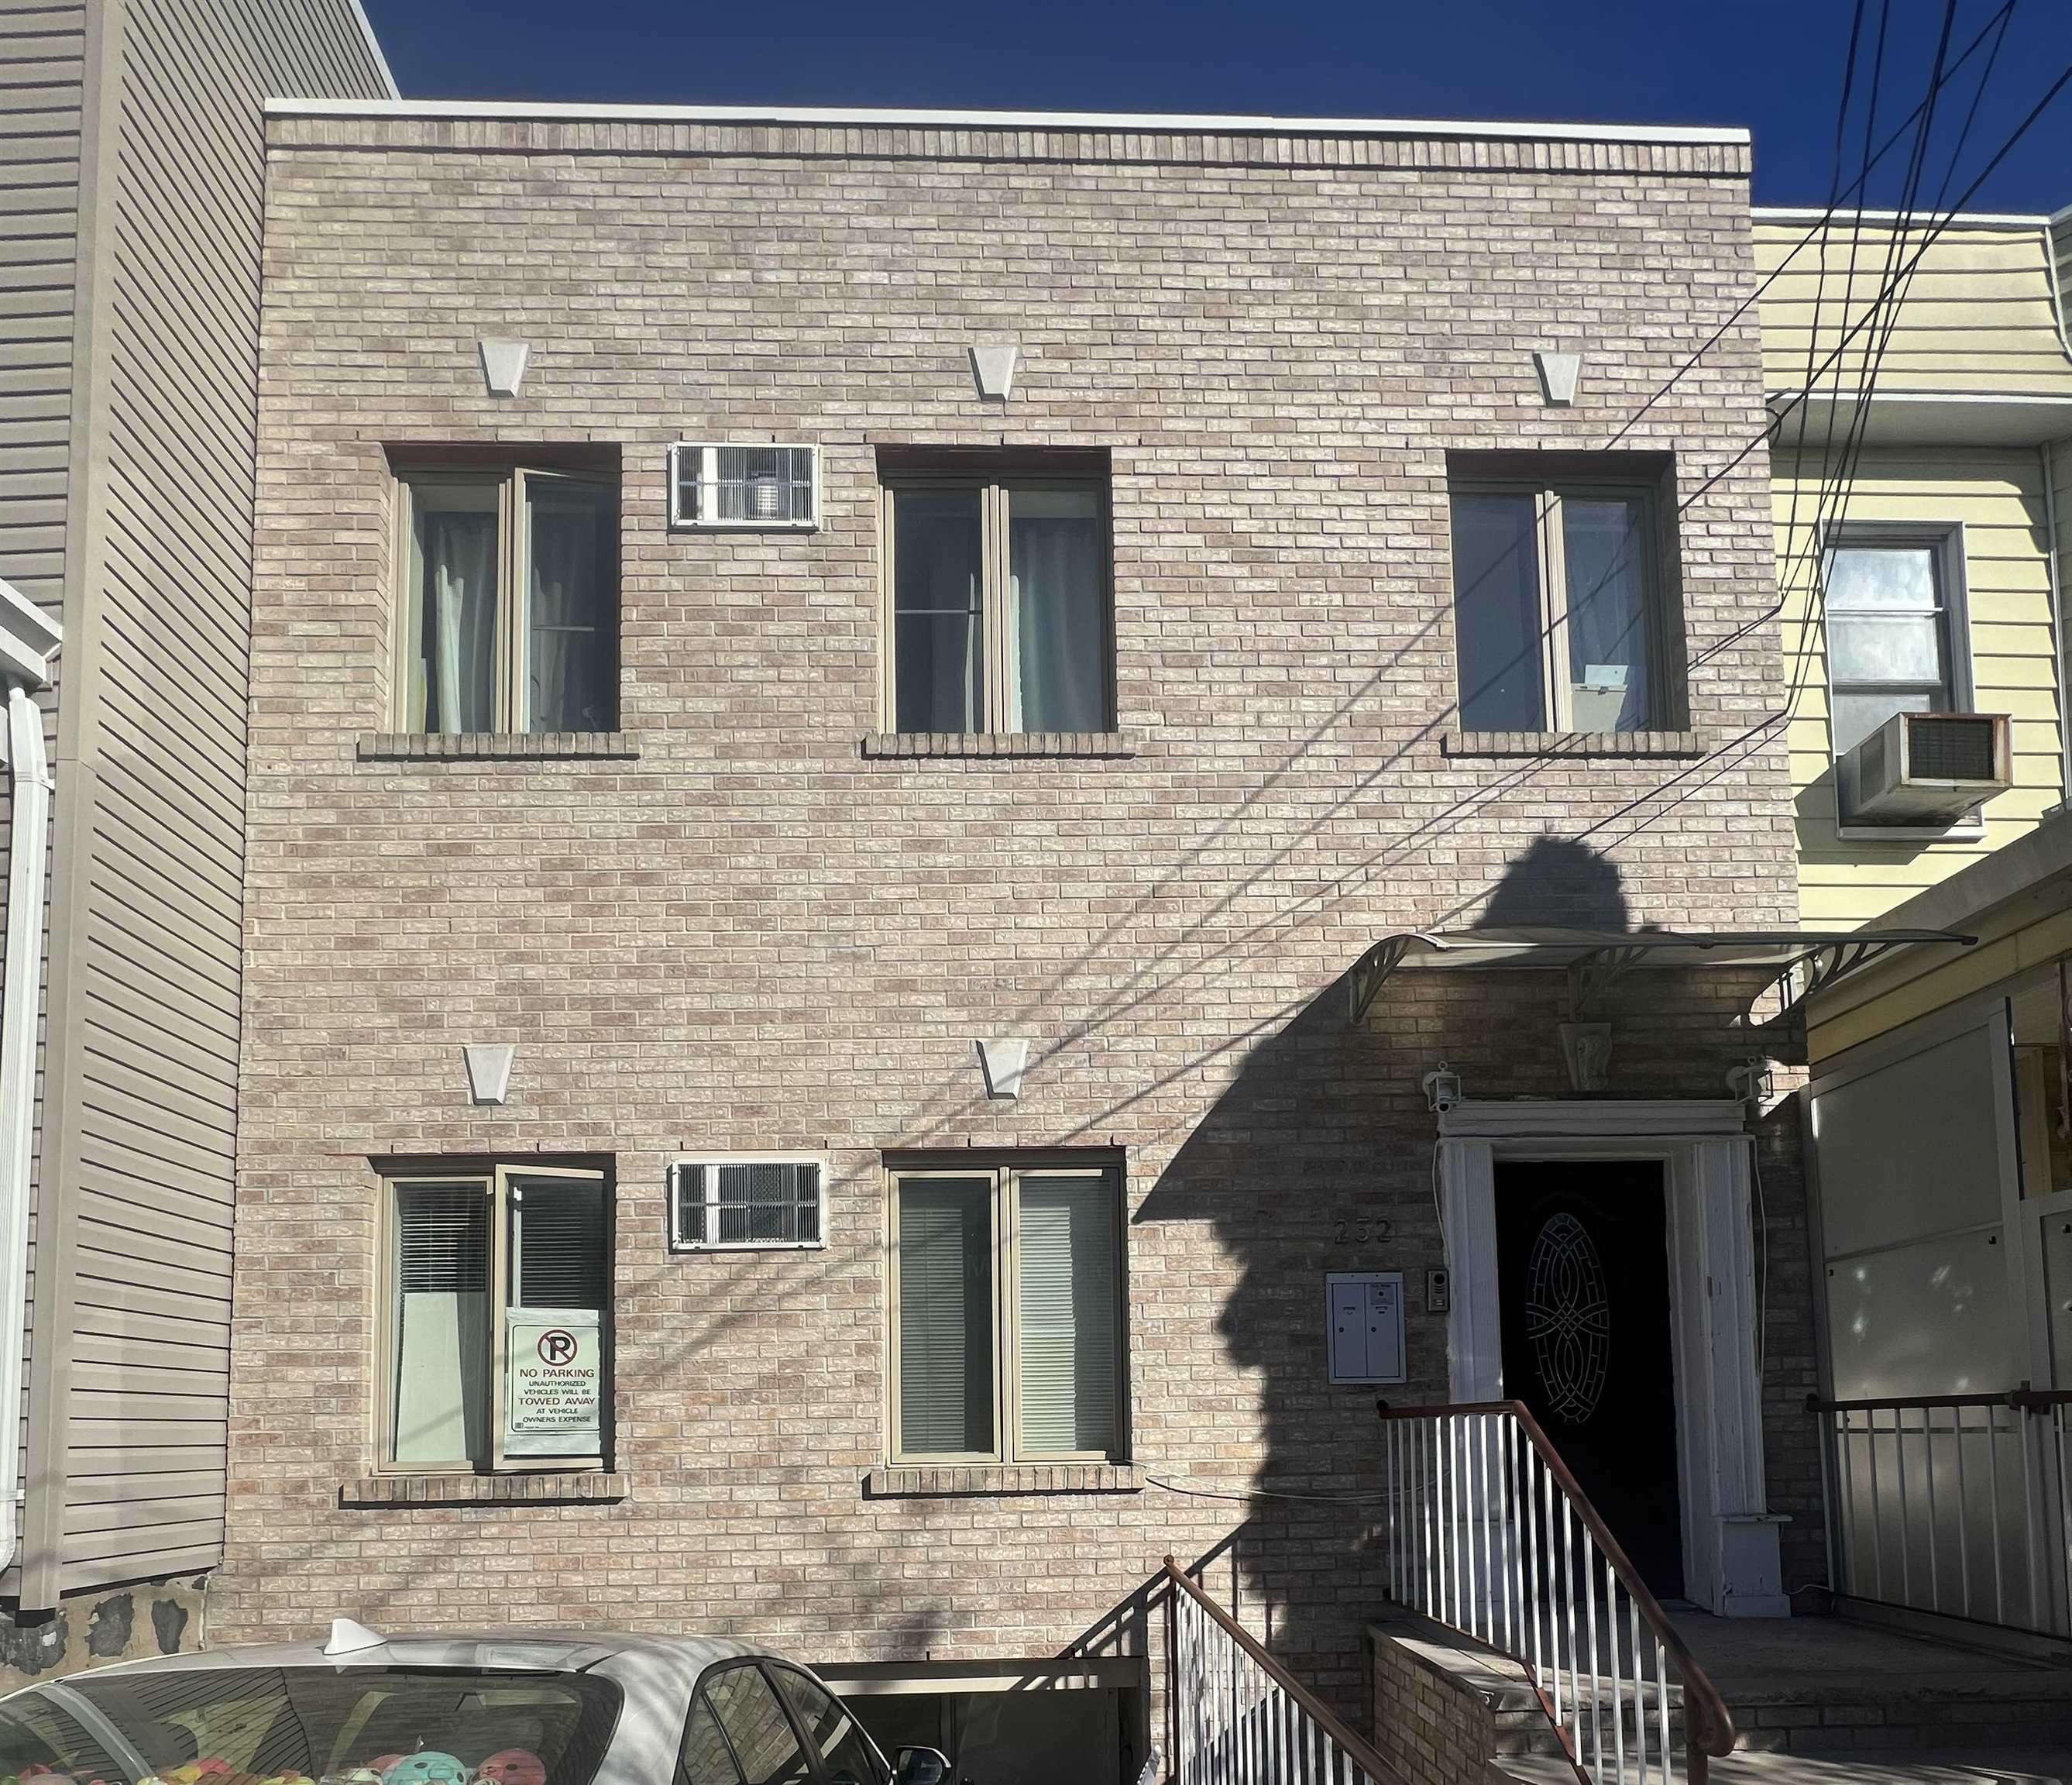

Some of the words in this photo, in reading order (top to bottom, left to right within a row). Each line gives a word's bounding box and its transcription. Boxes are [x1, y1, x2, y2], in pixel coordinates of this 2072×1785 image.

[1334, 1217, 1391, 1244] 232
[520, 1369, 538, 1377] NO
[543, 1369, 595, 1377] PARKING
